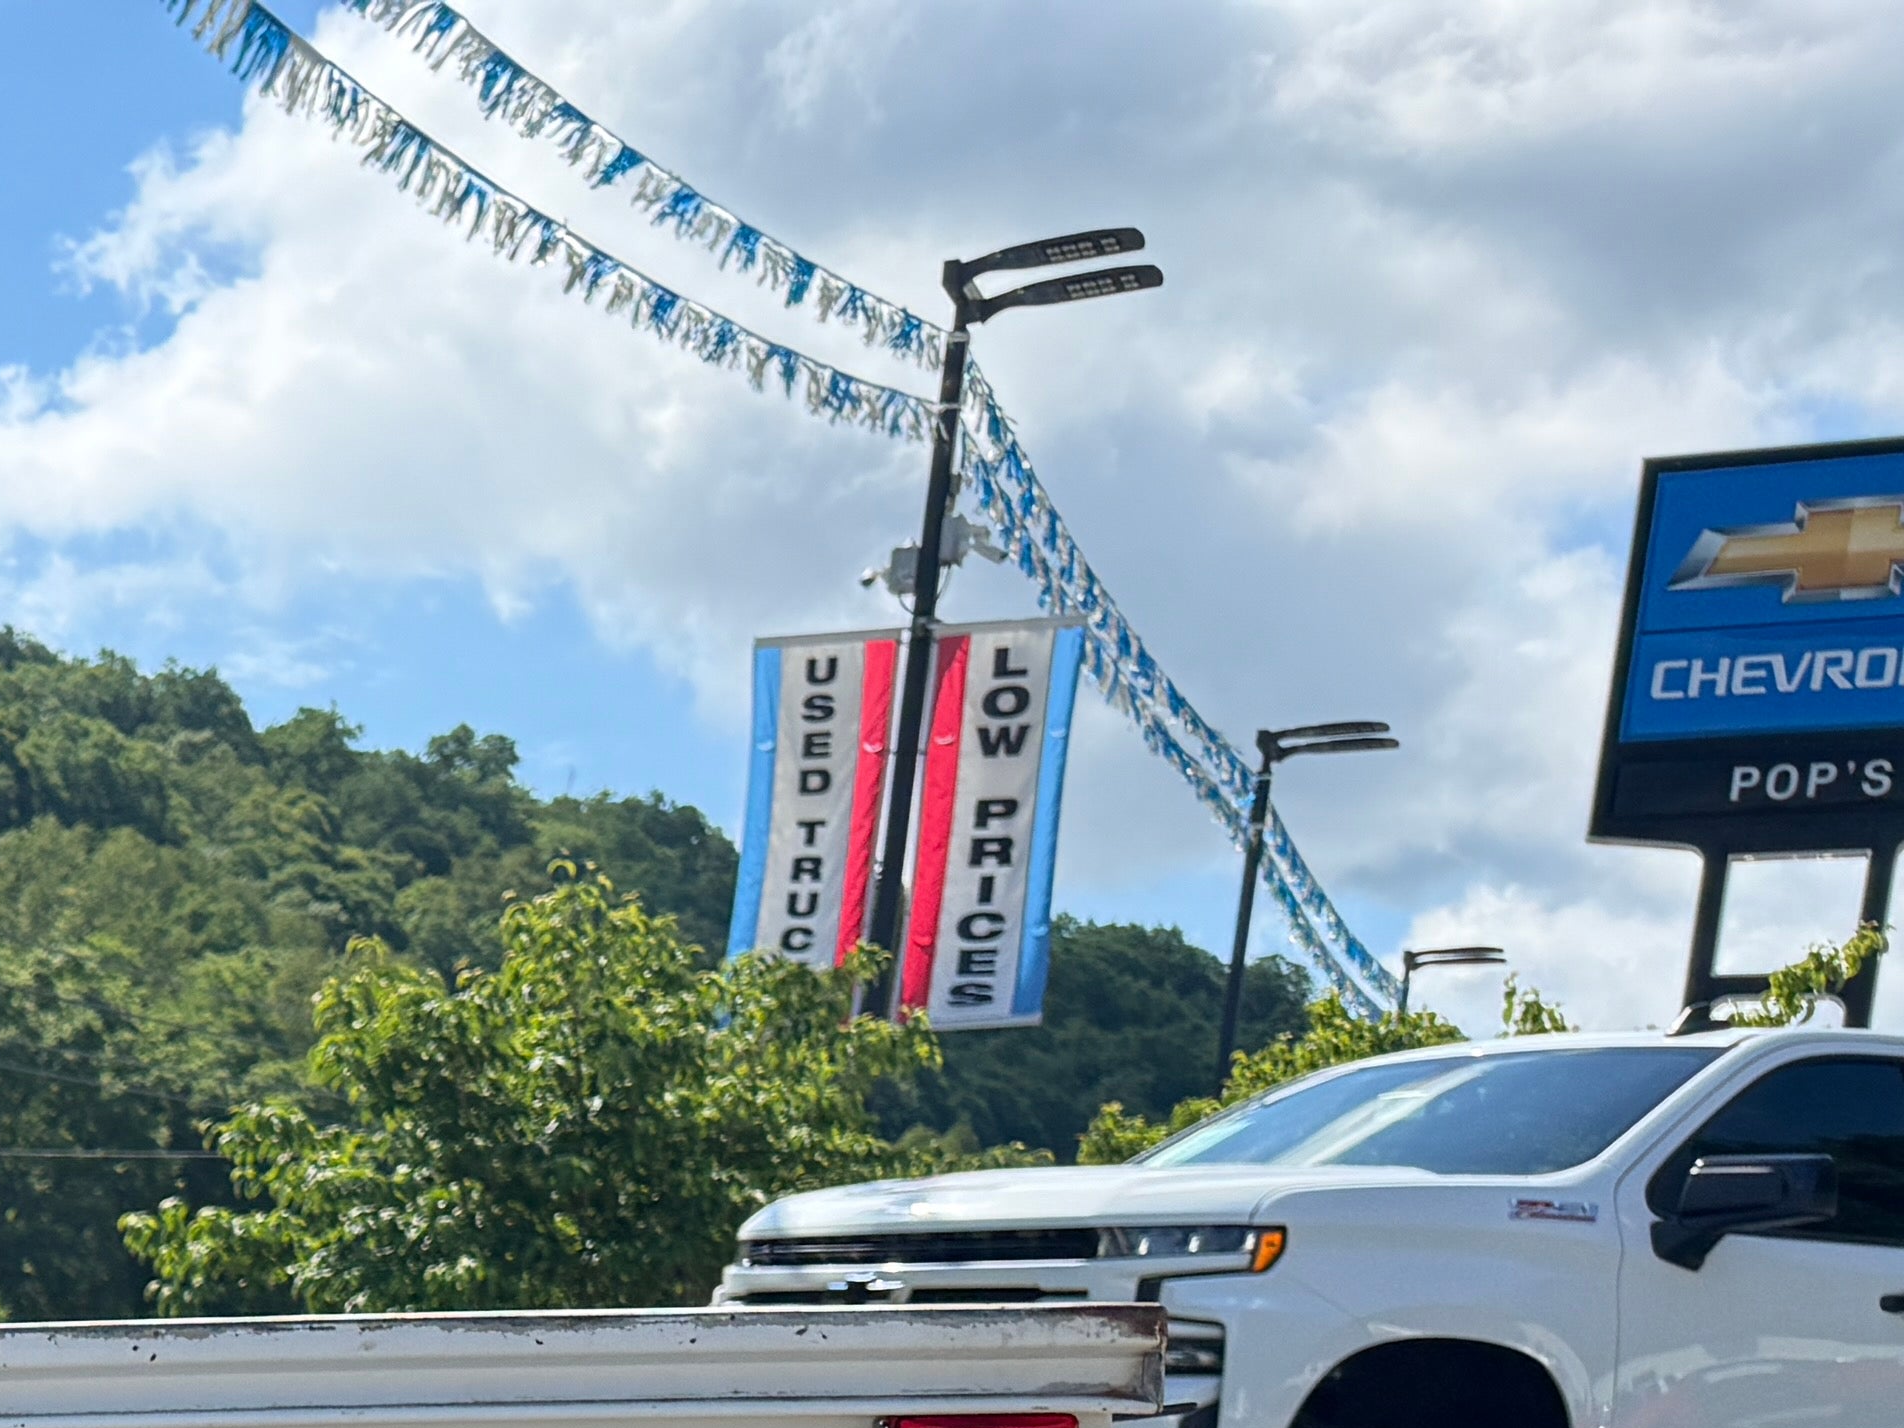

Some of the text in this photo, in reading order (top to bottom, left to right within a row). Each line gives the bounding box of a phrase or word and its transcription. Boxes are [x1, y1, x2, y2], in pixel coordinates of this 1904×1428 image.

[1649, 646, 1904, 700] CHEVRO
[774, 656, 839, 966] USED TRUC
[946, 646, 1032, 1008] LOW PRICES
[1728, 758, 1895, 803] POP'S
